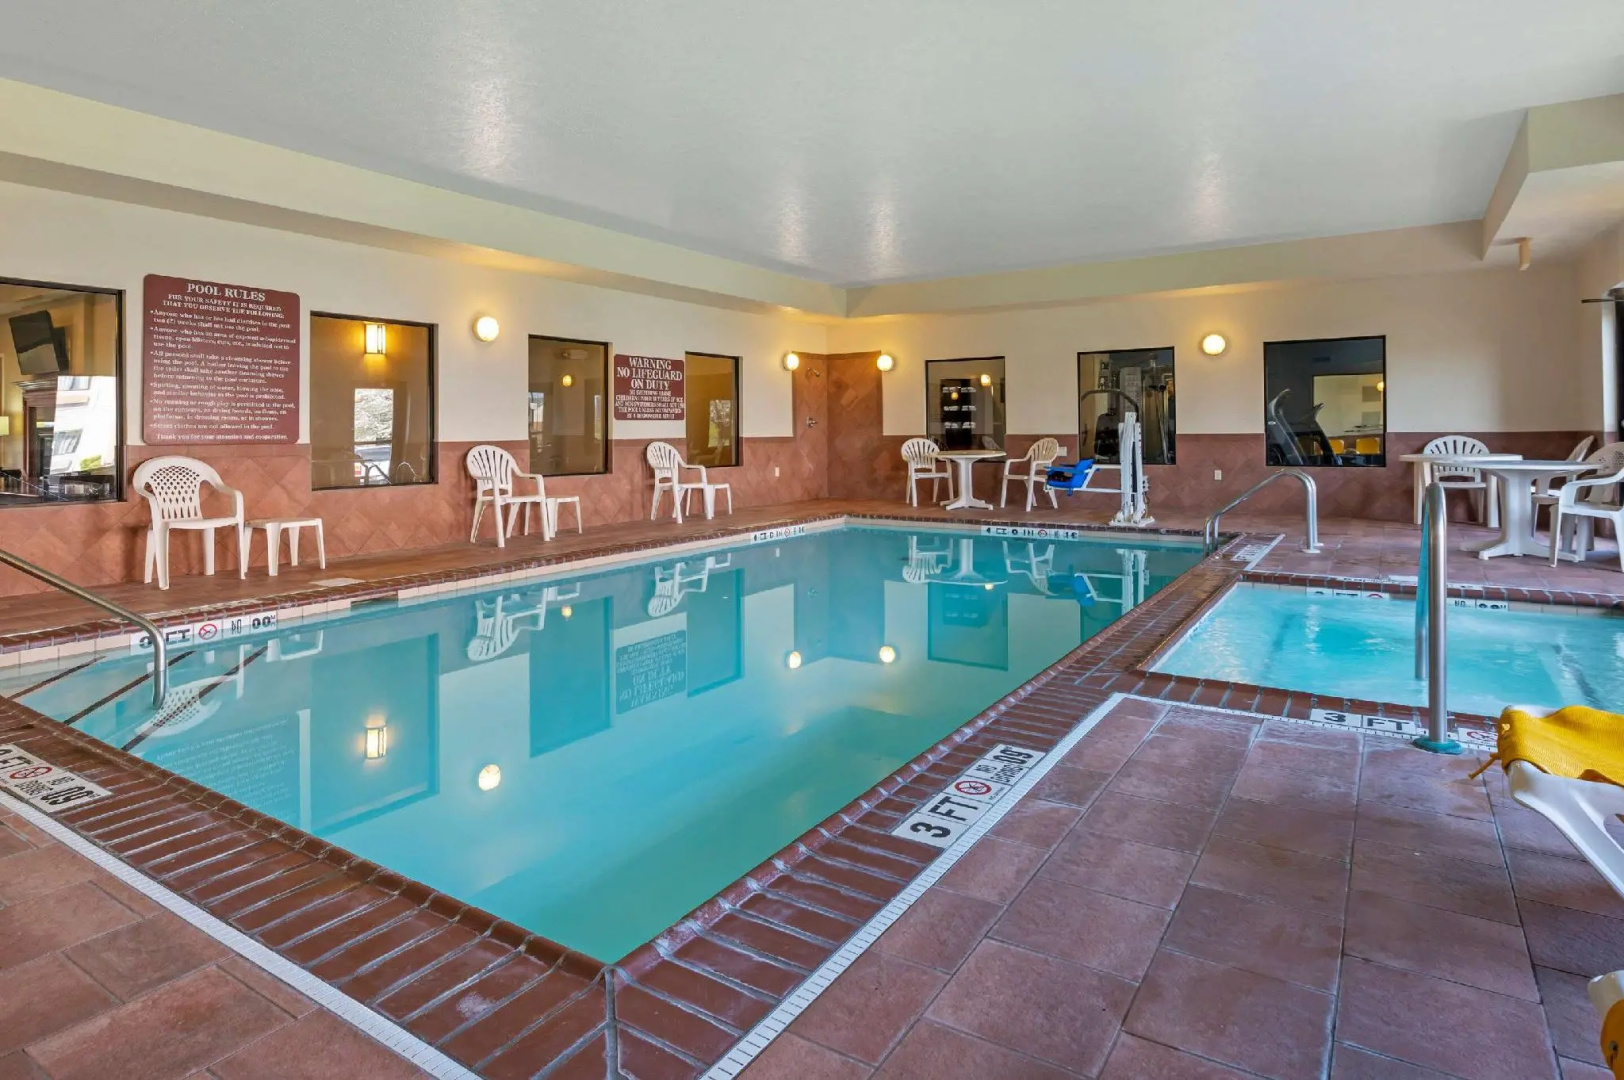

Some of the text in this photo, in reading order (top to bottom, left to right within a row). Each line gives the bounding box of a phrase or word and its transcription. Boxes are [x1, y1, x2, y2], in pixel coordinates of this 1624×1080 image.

[187, 283, 265, 301] POOL RULES
[200, 305, 230, 313] OBSERVE
[246, 310, 284, 318] FOLLOWING:
[629, 357, 671, 370] WARNING
[617, 367, 682, 380] NO LIFEGUARD
[631, 379, 669, 390] ON DUTY
[1324, 712, 1409, 730] 3 FT
[910, 796, 978, 838] 3 FT
